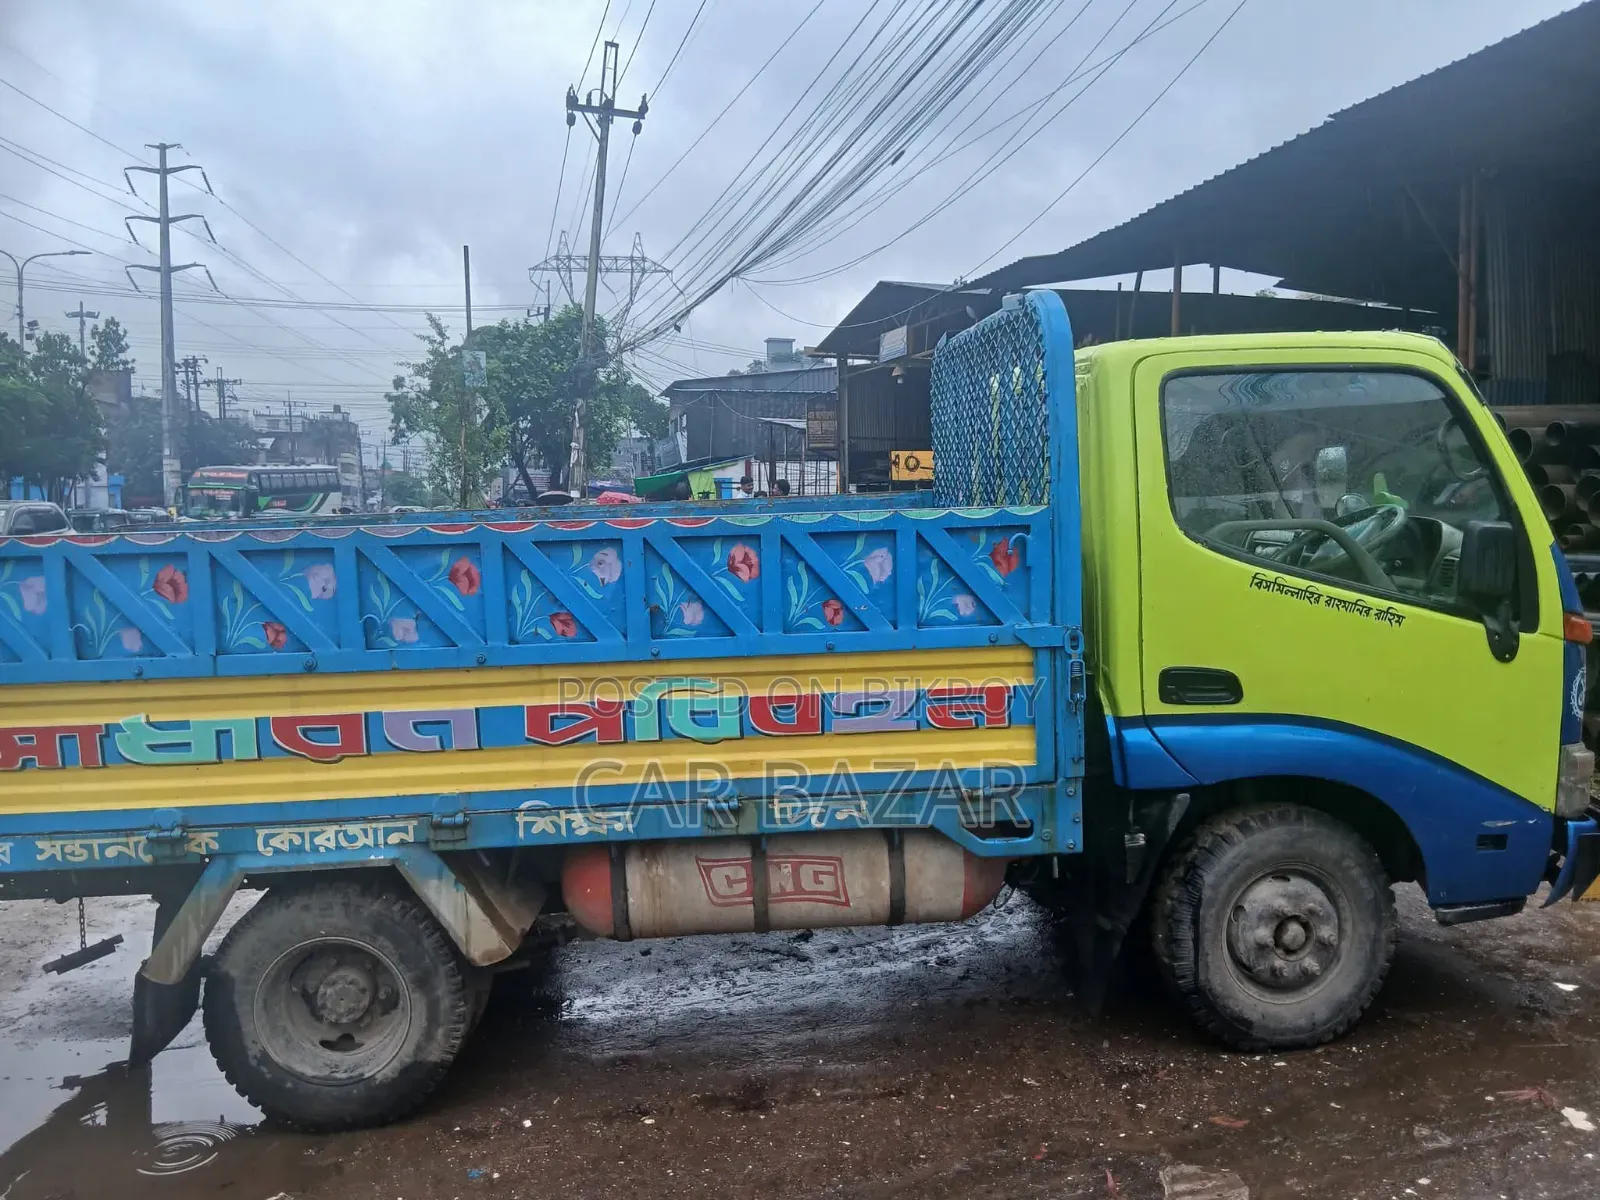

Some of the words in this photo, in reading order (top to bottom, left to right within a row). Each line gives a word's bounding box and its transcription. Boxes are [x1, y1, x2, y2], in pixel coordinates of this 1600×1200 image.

[1249, 572, 1324, 606] বিসমিল্লাহির
[1374, 606, 1406, 628] রাহিম
[524, 678, 1015, 744] পরিবহন
[255, 818, 418, 857] কোরআন
[709, 863, 838, 897] CNG
